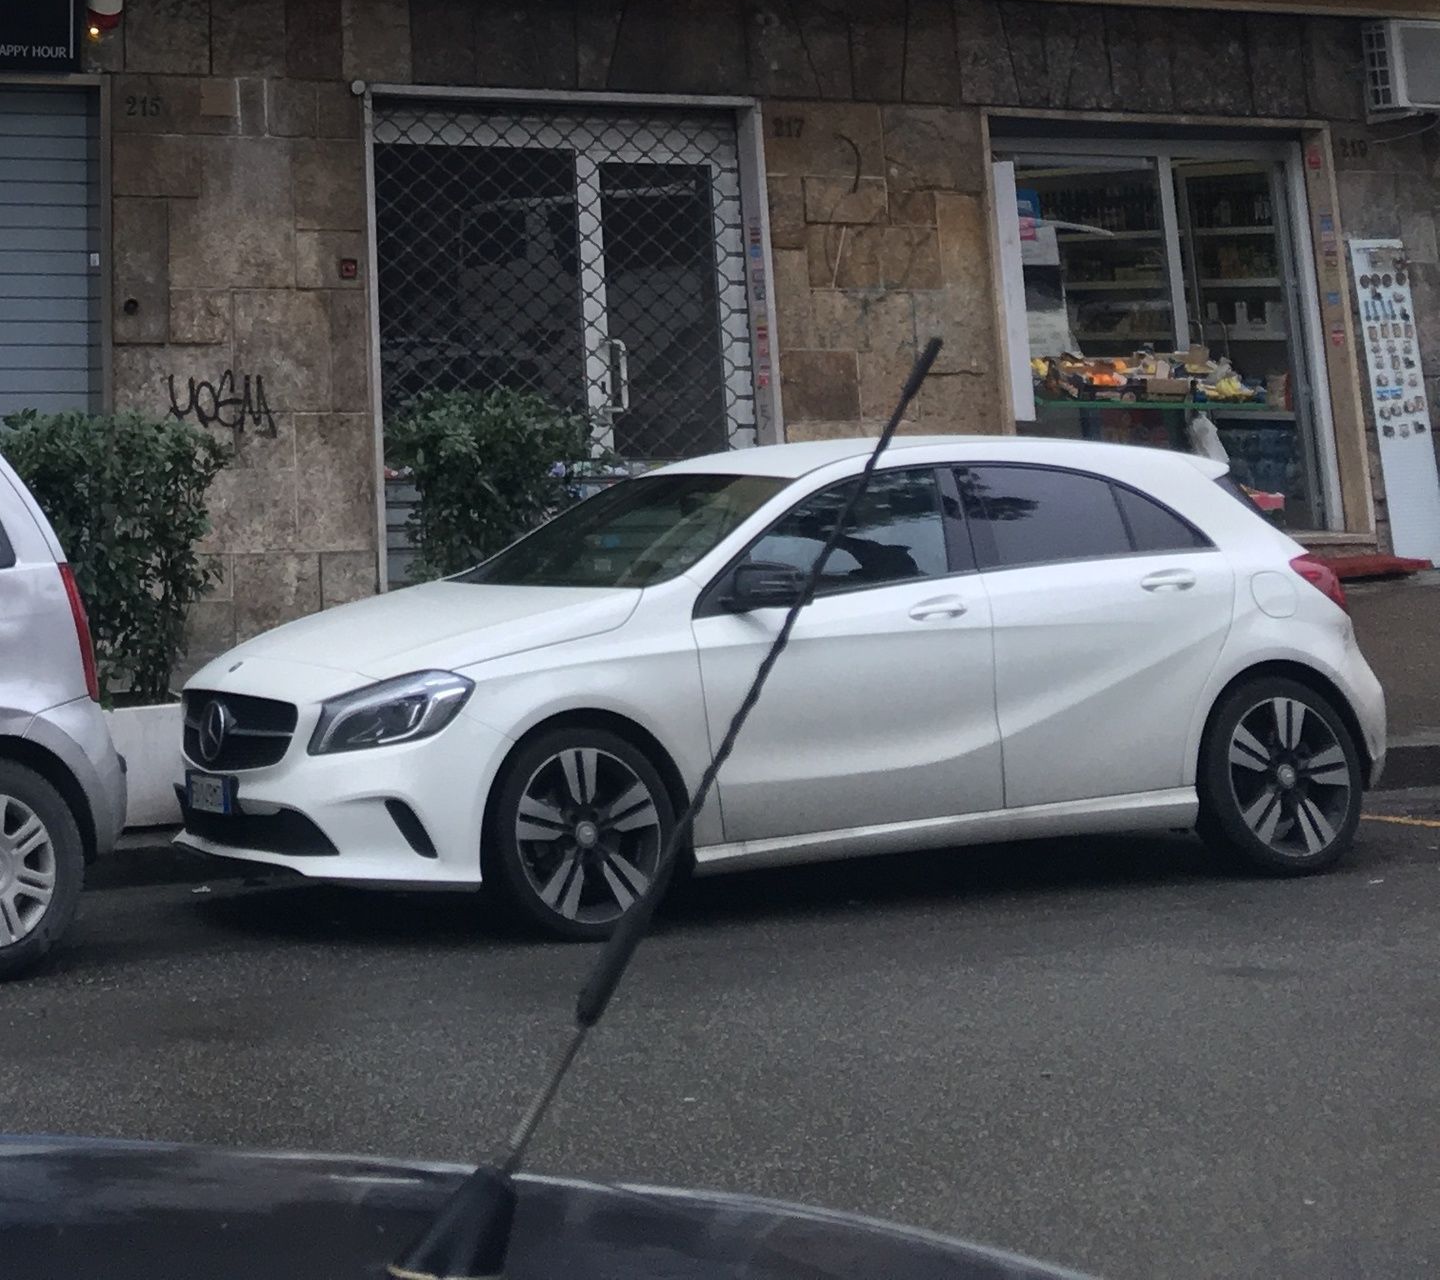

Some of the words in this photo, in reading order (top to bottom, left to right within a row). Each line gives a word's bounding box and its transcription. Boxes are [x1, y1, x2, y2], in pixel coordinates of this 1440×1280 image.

[32, 46, 67, 58] HOUR
[126, 95, 163, 117] 215
[772, 117, 805, 138] 217
